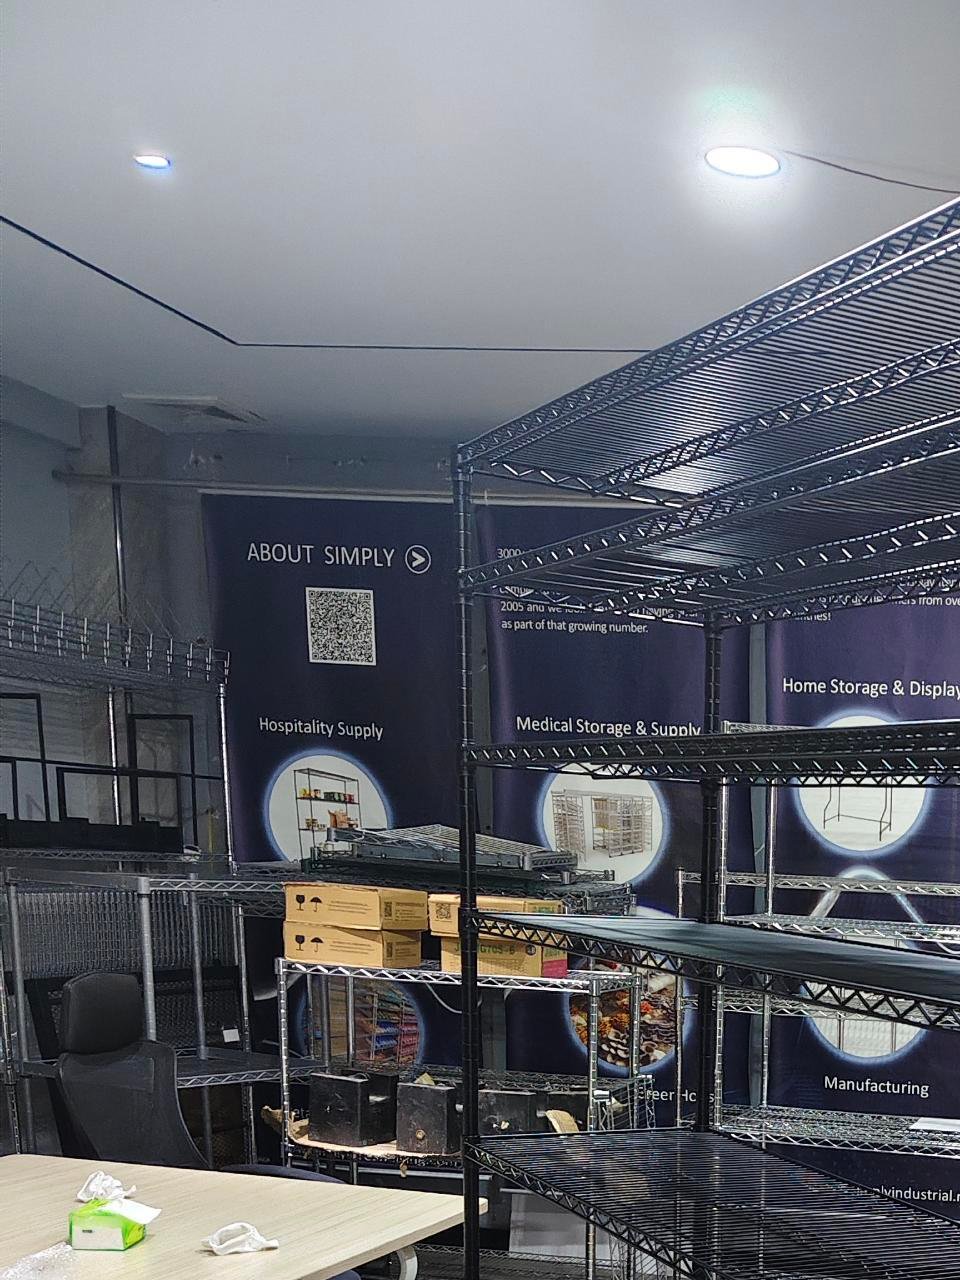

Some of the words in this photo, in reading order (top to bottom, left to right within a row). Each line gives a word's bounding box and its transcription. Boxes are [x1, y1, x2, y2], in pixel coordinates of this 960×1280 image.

[247, 542, 313, 564] ABOUT
[324, 545, 395, 567] SIMPLY
[501, 620, 513, 630] as
[514, 619, 534, 631] part
[535, 619, 546, 630] of
[547, 619, 566, 631] that
[568, 620, 608, 634] growing
[609, 622, 649, 633] number.
[783, 677, 827, 693] Home
[830, 679, 889, 698] Storage
[893, 680, 905, 697] &
[259, 716, 334, 739] Hospitality
[337, 721, 384, 743] Supply
[516, 716, 573, 733] Medical
[576, 718, 631, 738] Storage
[635, 720, 648, 736] &
[651, 721, 701, 737] Supply
[824, 1075, 930, 1098] Manufacturing
